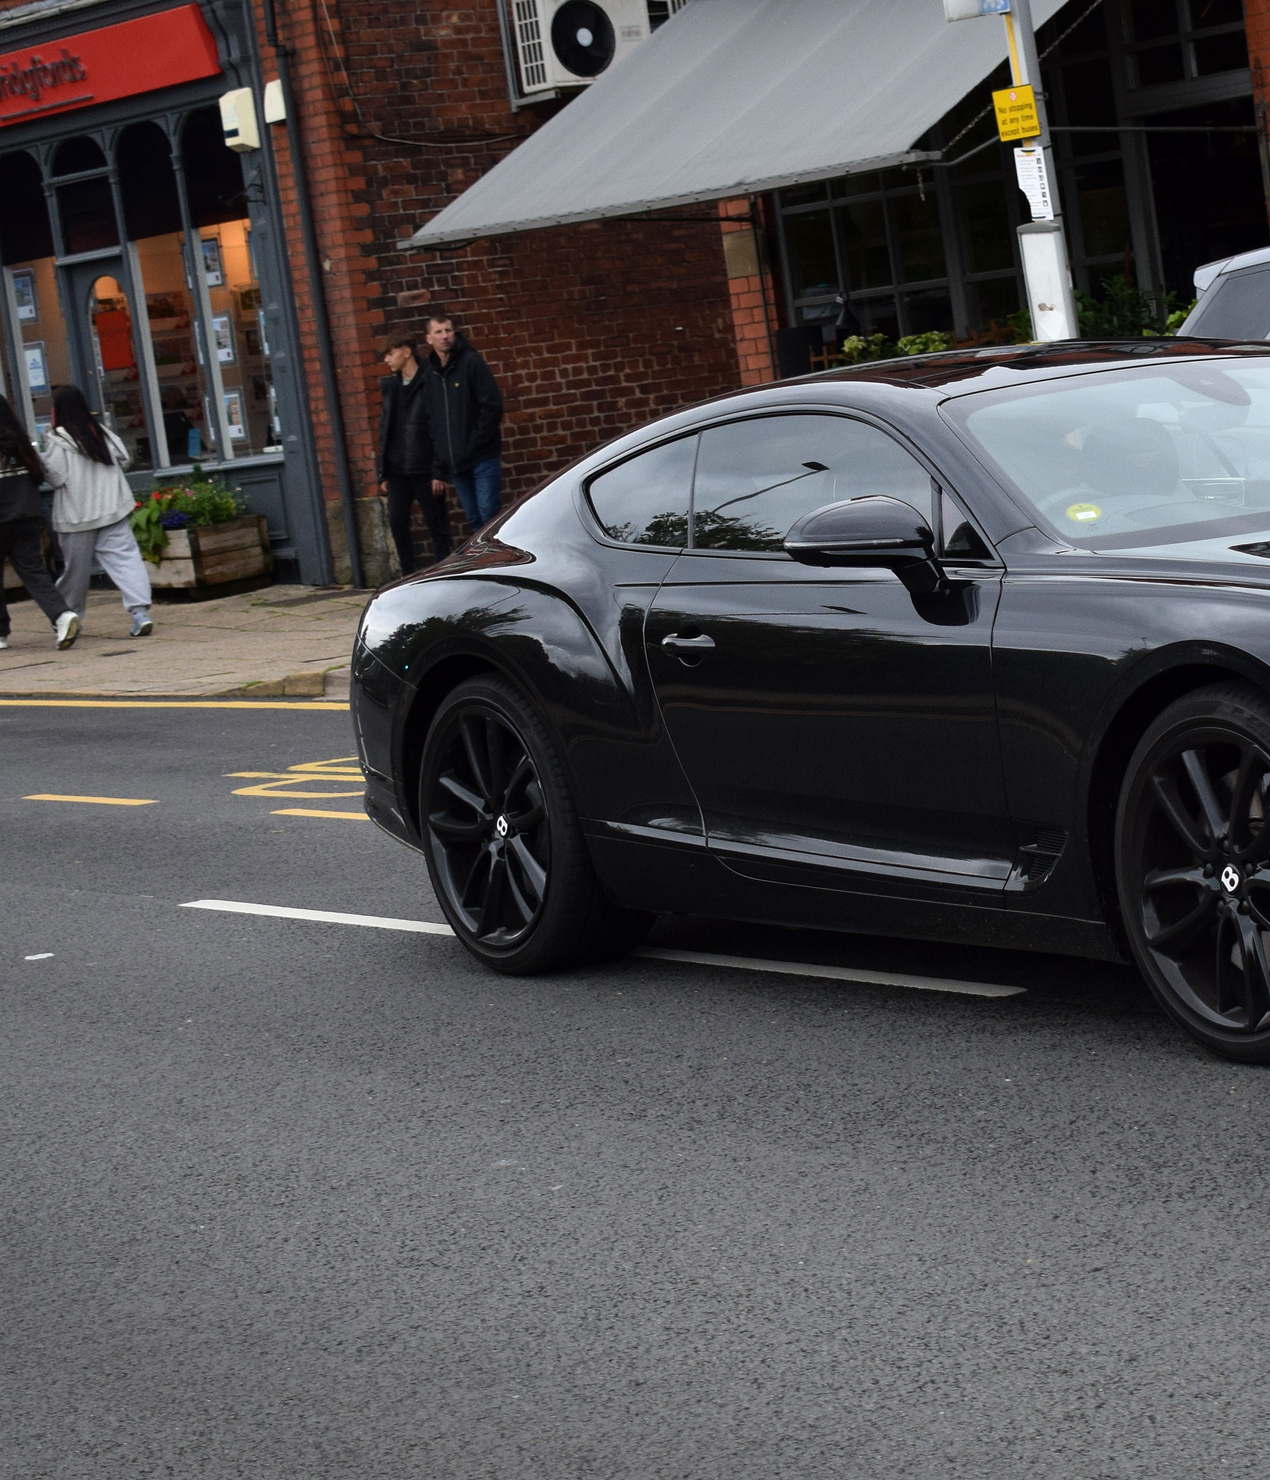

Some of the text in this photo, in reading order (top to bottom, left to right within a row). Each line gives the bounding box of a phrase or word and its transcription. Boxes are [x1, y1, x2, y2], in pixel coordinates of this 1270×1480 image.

[0, 47, 87, 102] ridgfords
[1009, 103, 1032, 112] stopping
[1002, 118, 1008, 126] at
[1021, 114, 1034, 122] time
[1001, 125, 1038, 137] except buses
[1221, 866, 1240, 892] B
